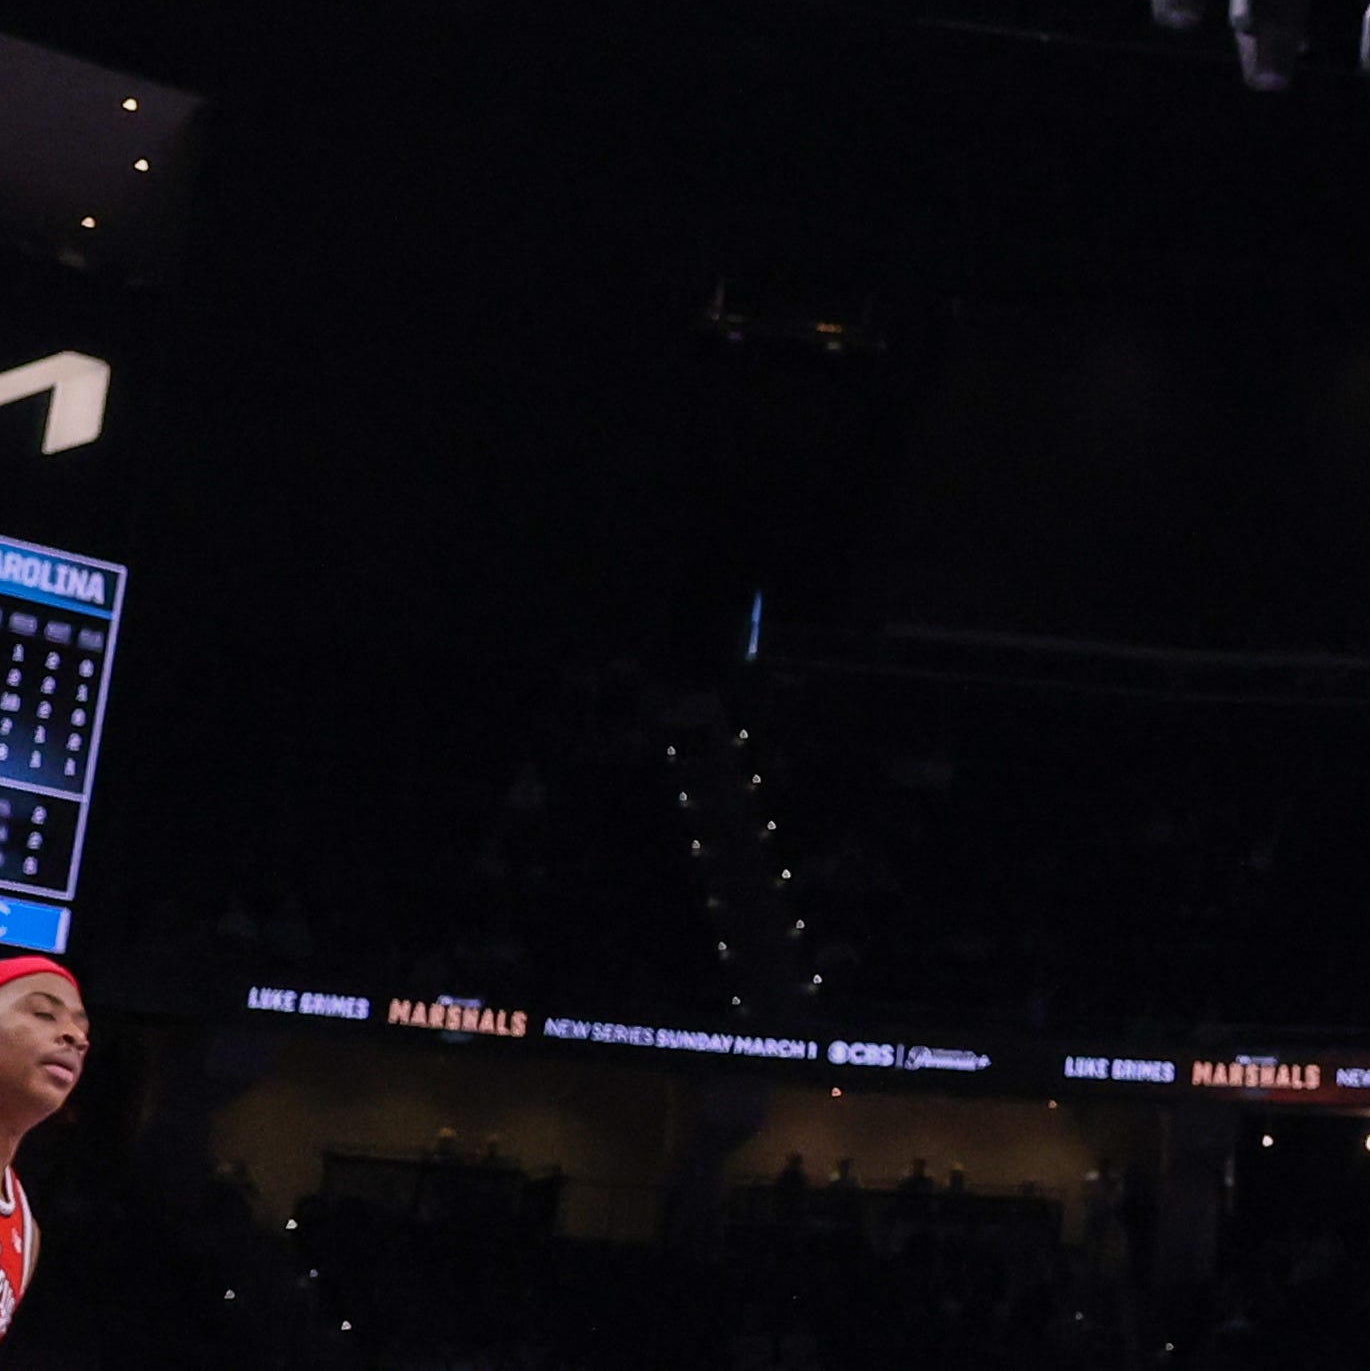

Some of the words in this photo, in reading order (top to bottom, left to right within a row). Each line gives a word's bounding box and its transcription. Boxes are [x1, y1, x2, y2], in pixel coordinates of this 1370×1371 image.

[388, 998, 528, 1038] MARSHALS
[543, 1017, 590, 1039] NEW
[590, 1023, 654, 1045] SERIES
[655, 1028, 733, 1053] SUNDAY
[732, 1036, 806, 1059] MARCH
[849, 1042, 895, 1067] CBS
[1192, 1060, 1321, 1090] MARSHALS
